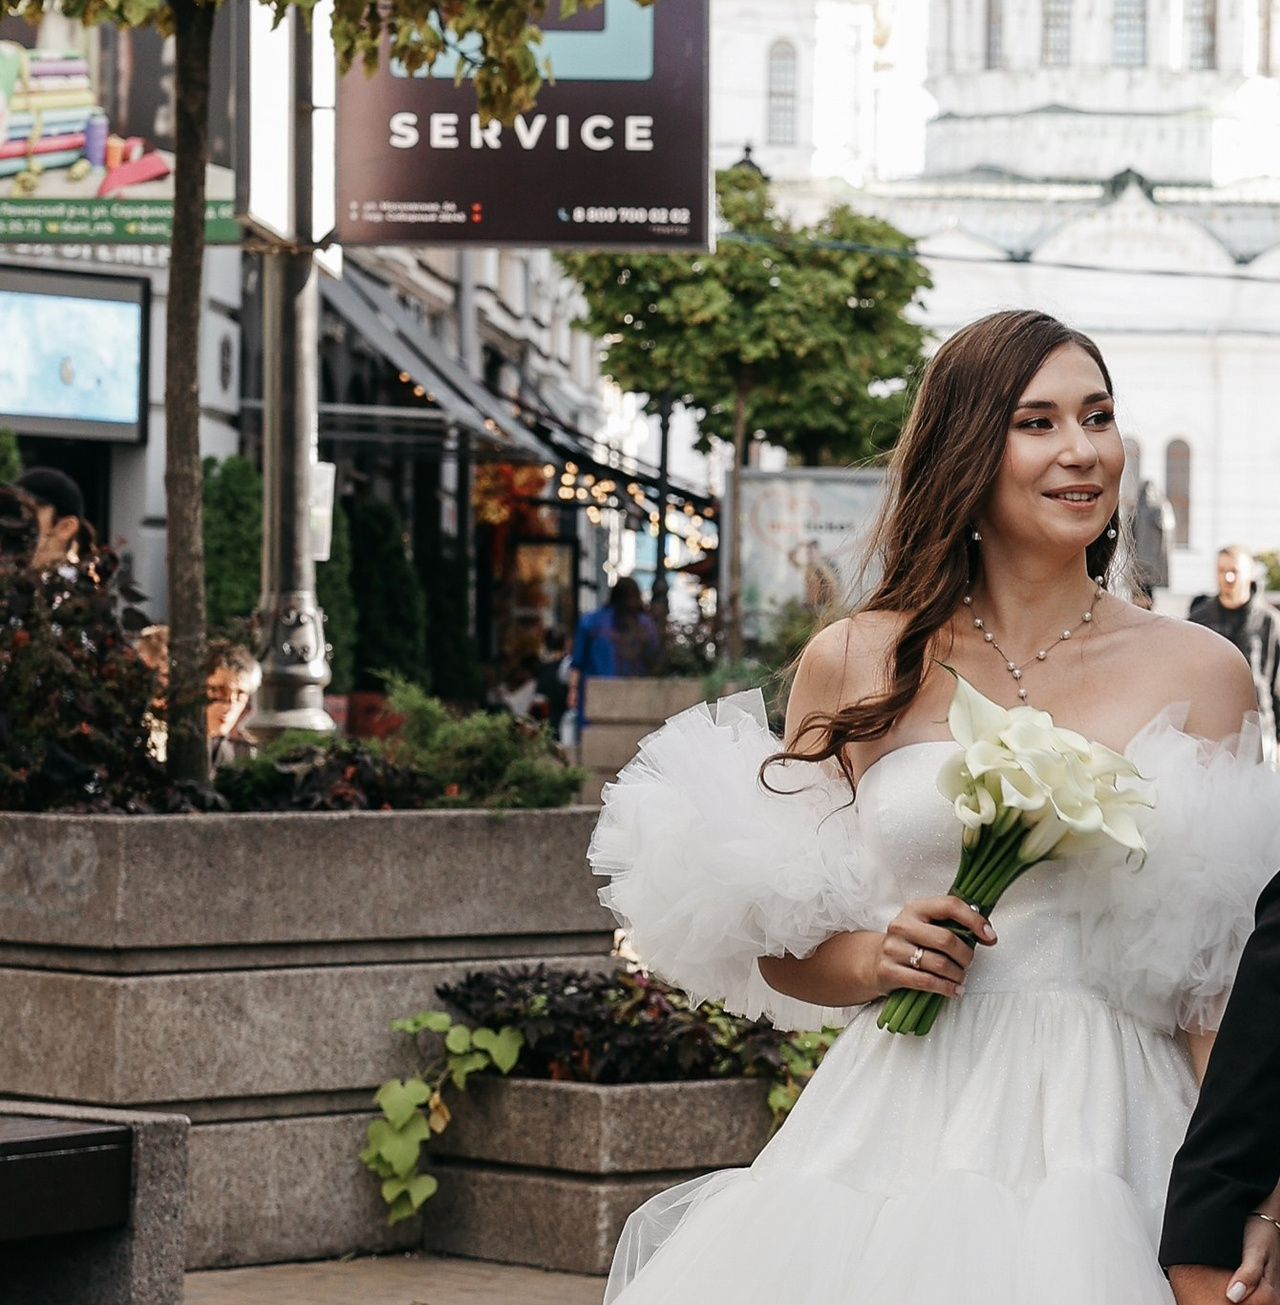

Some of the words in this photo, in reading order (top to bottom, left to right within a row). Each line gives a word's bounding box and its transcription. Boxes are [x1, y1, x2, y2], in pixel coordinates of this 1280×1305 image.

[389, 112, 655, 151] SERVICE
[573, 206, 585, 223] 8
[586, 206, 617, 223] 800
[617, 207, 647, 224] 700
[648, 207, 669, 224] 02
[669, 207, 691, 224] 02
